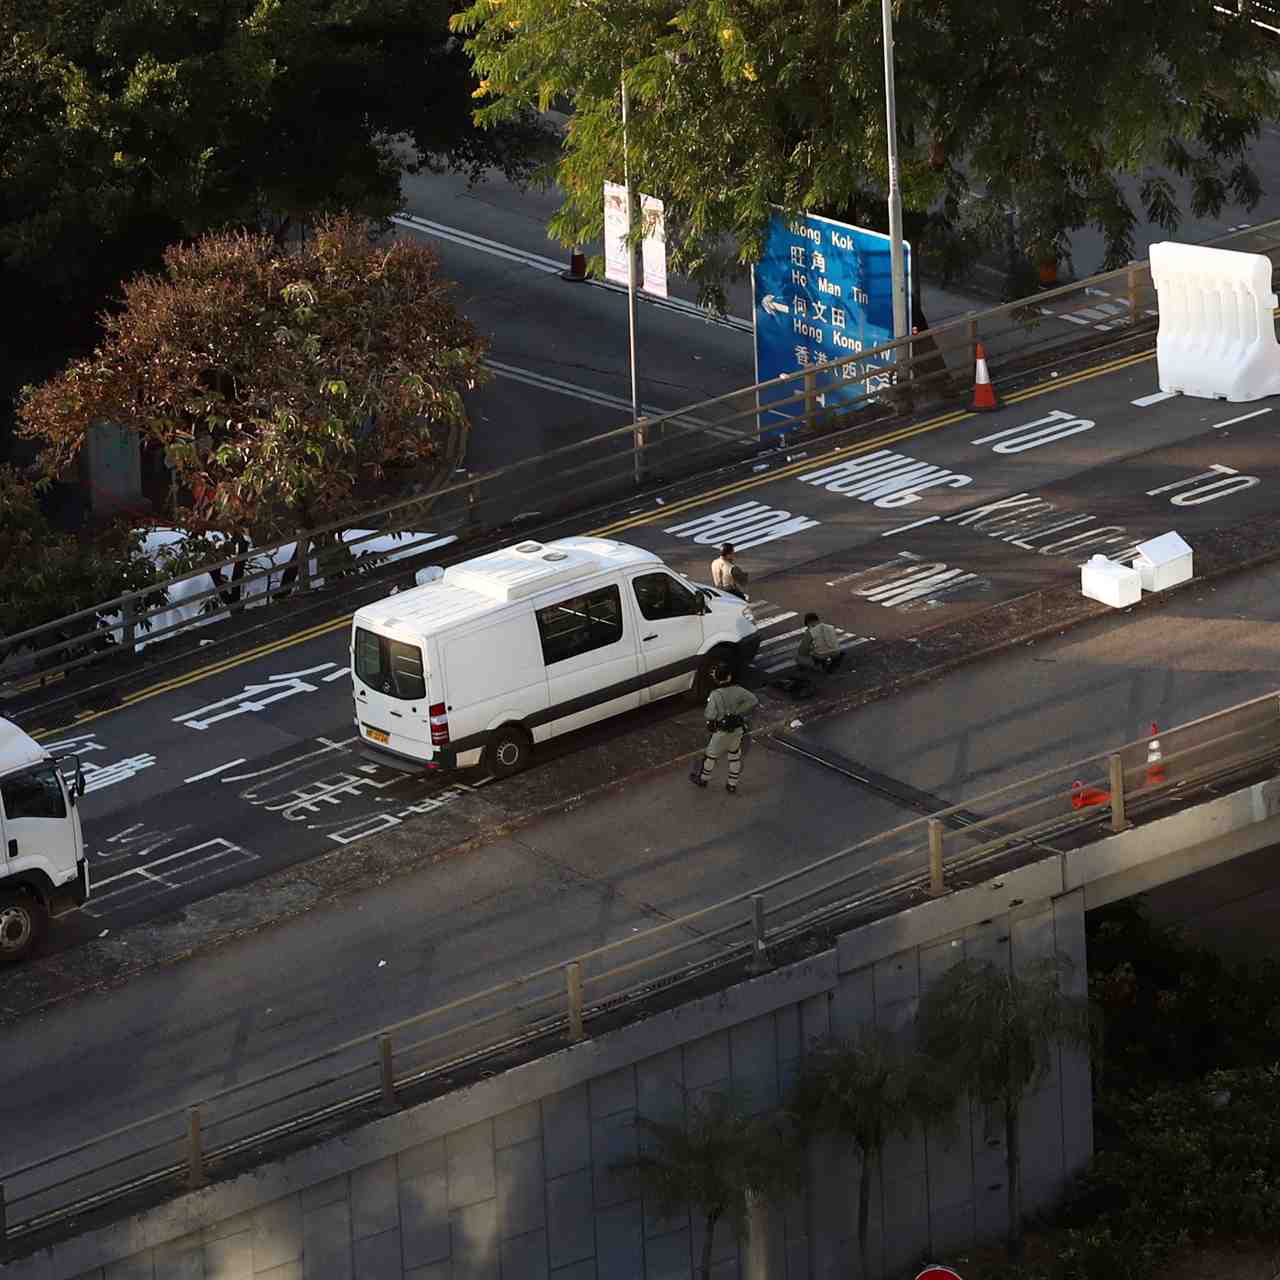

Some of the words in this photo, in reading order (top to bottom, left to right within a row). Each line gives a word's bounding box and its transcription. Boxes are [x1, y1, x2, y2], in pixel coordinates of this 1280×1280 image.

[790, 220, 821, 245] Mong
[831, 230, 854, 251] Kok
[790, 245, 825, 272] 旺角
[791, 270, 807, 287] Ho
[818, 276, 841, 297] Man
[851, 285, 869, 305] Tin
[792, 295, 845, 329] 何文田
[793, 318, 822, 343] Hong
[833, 330, 862, 353] Kong
[971, 409, 1097, 454] TO
[797, 449, 973, 508] HUNG
[1145, 463, 1261, 507] TO
[663, 500, 820, 551] HOM
